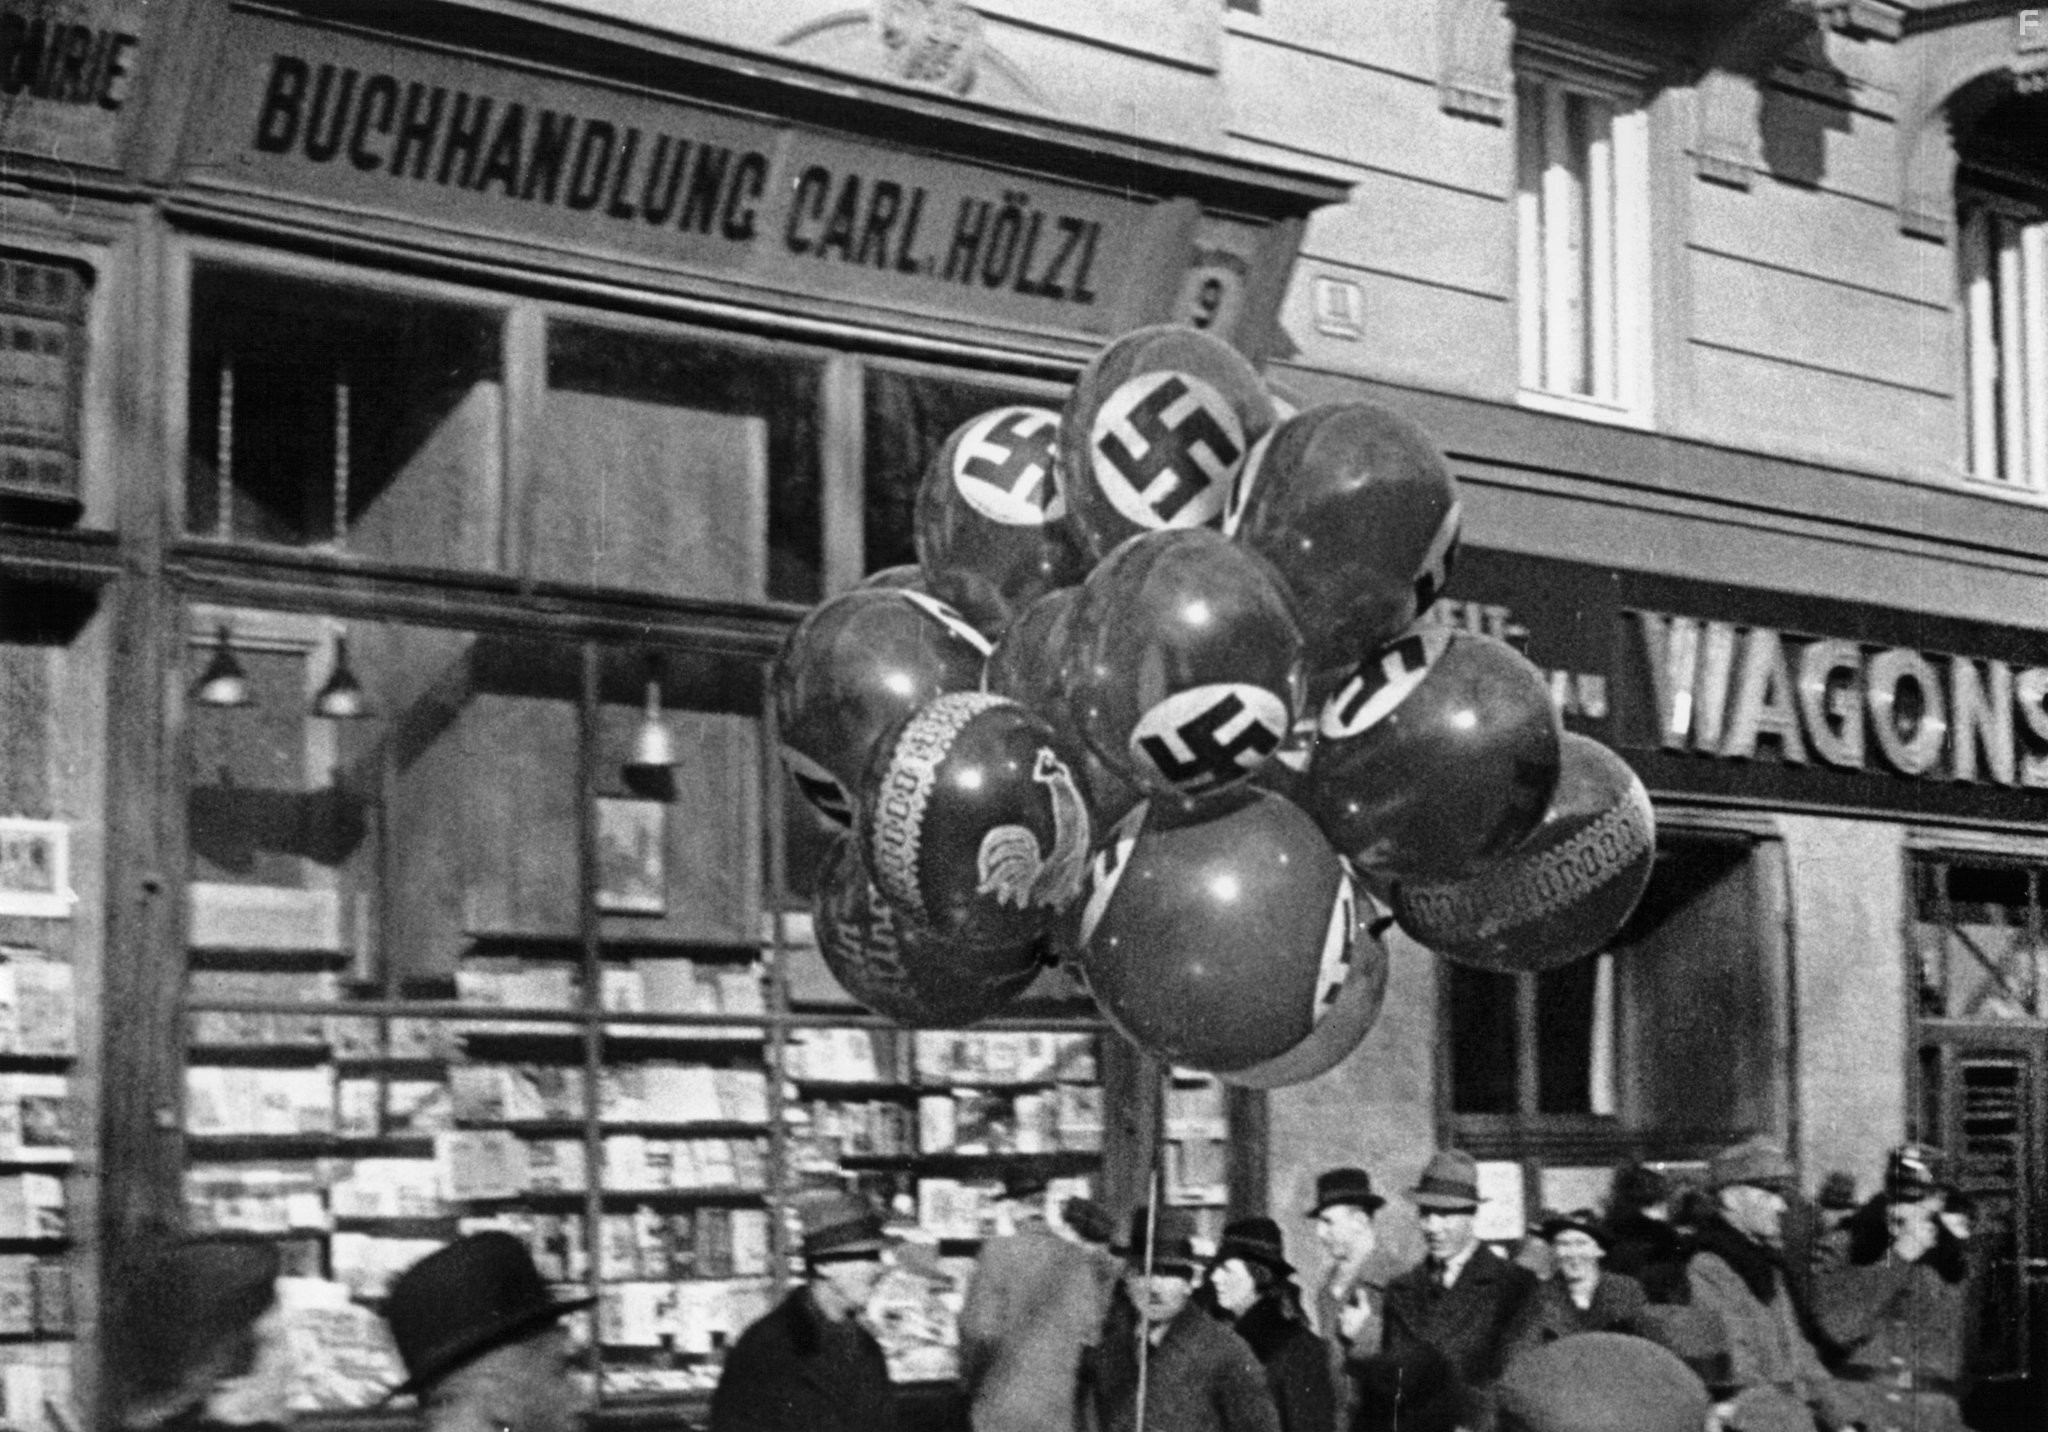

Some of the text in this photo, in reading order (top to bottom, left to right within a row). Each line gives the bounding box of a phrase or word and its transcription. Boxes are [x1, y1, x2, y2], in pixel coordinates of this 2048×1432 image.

[255, 54, 769, 241] BUCHHANDLUNG
[943, 189, 1101, 306] HÖLZL
[1193, 278, 1222, 329] 9
